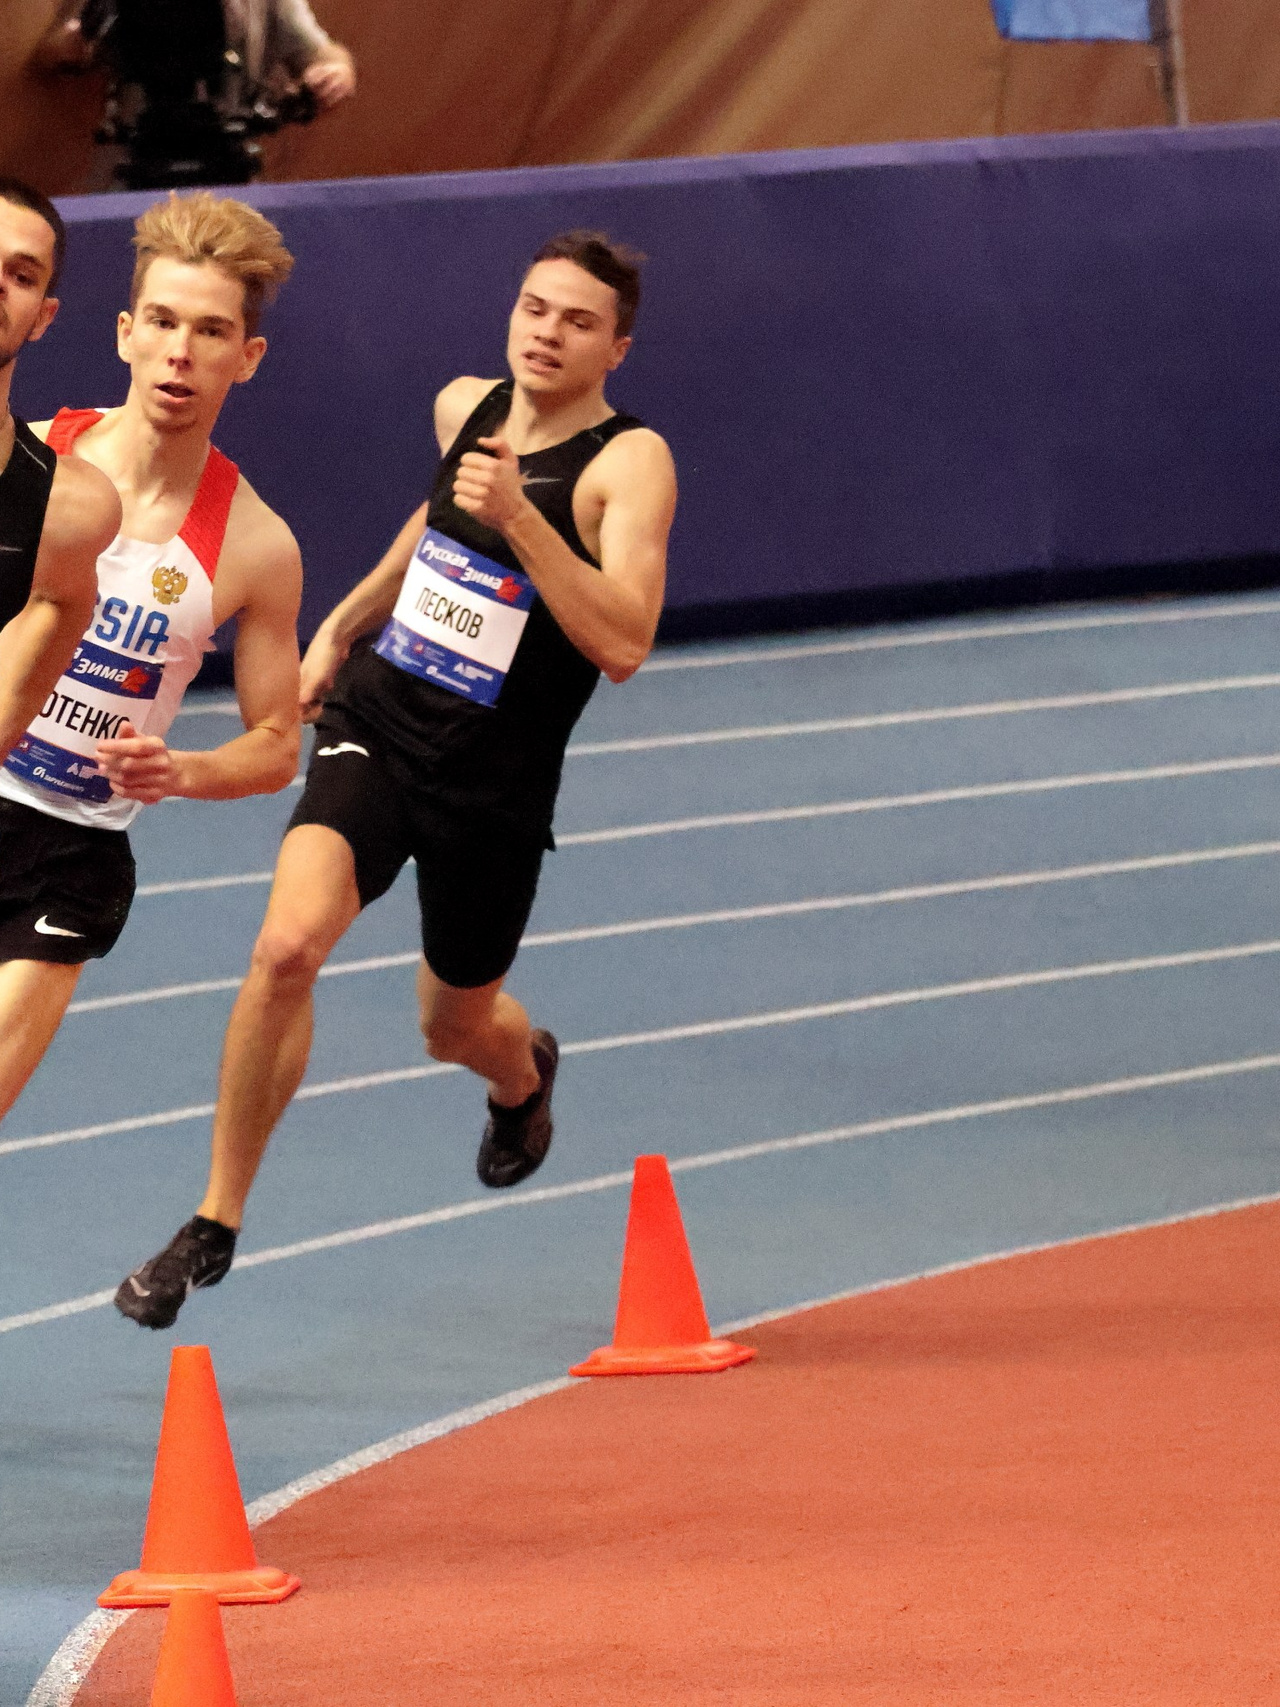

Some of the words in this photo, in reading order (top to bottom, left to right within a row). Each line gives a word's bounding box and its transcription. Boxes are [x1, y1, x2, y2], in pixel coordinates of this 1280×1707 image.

[460, 566, 503, 590] Зима
[95, 595, 170, 656] SIA
[414, 587, 484, 639] ПЕСКОВ
[73, 658, 129, 683] Зима
